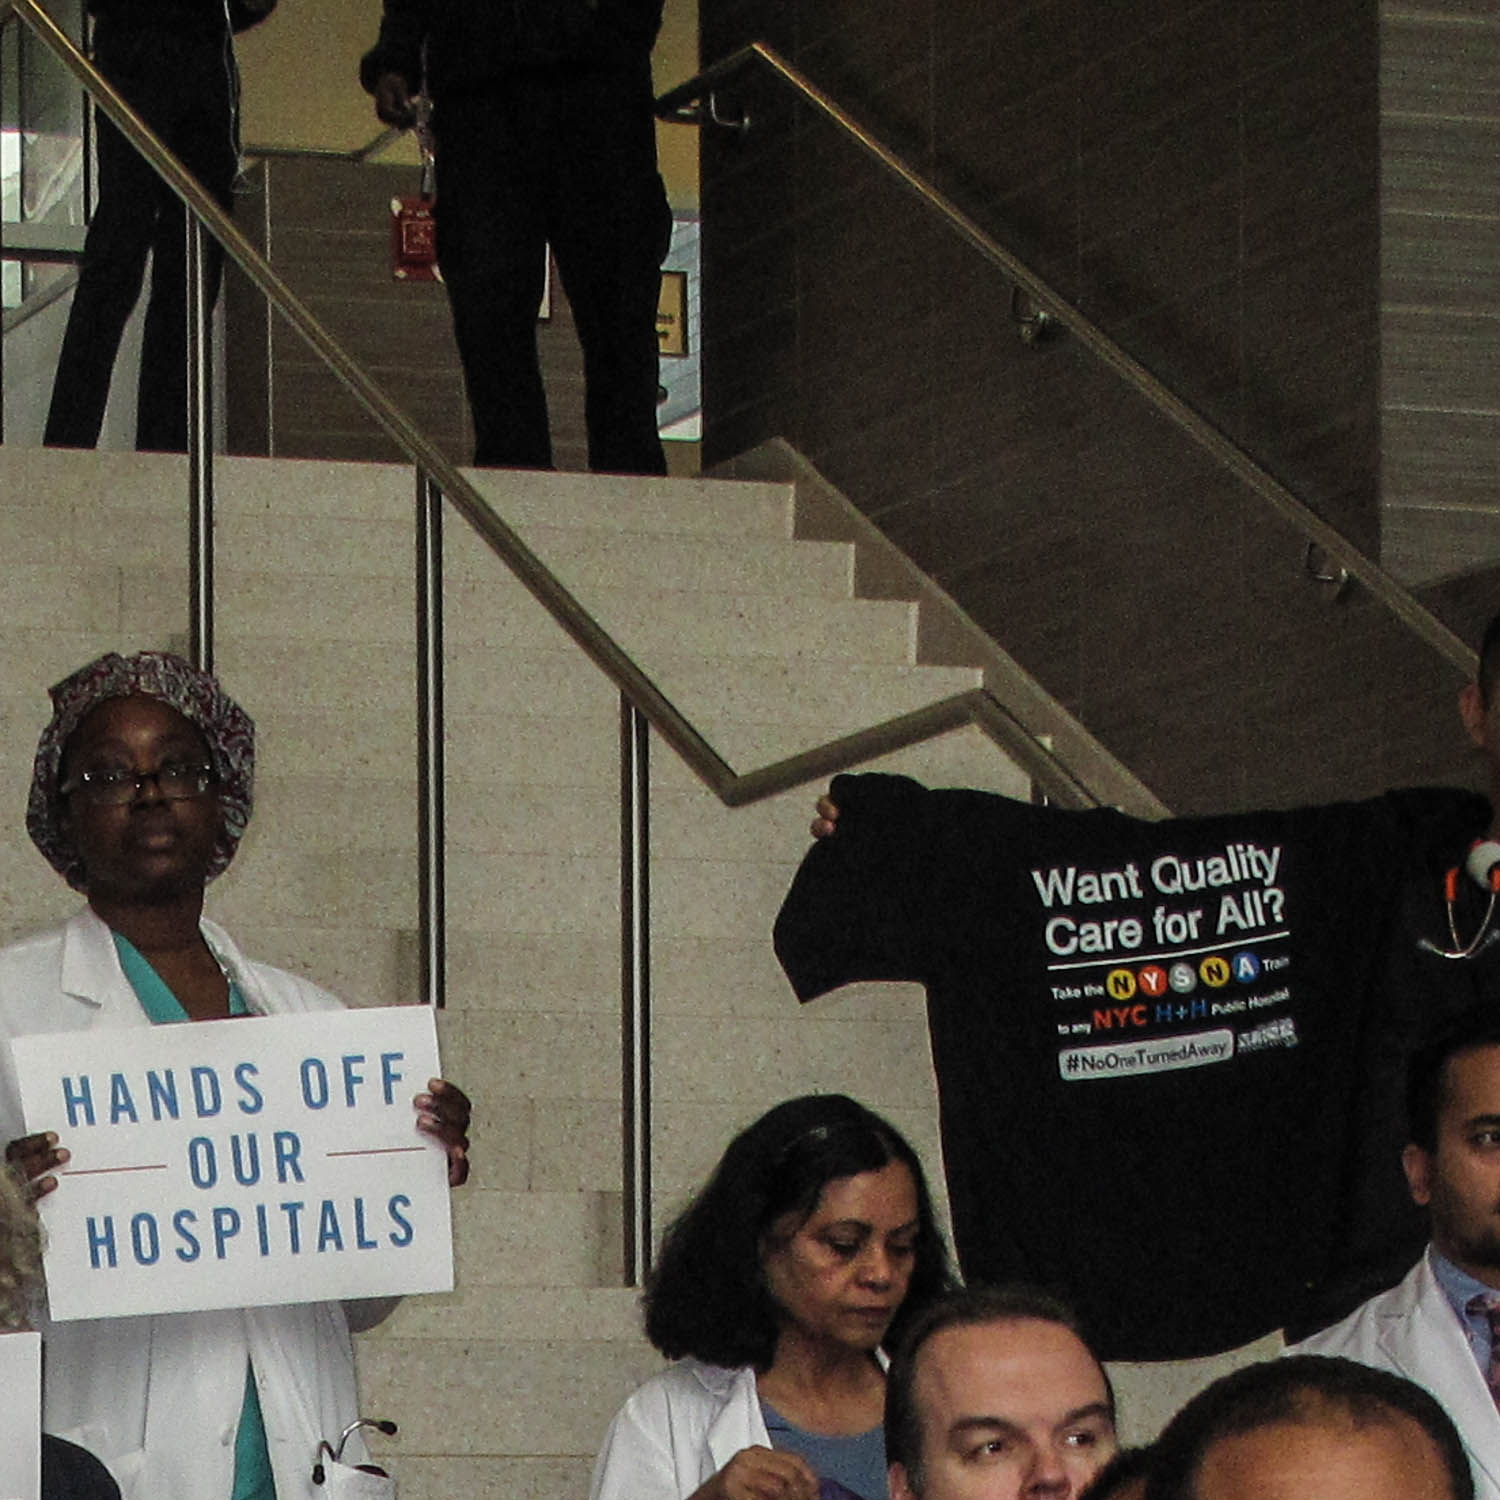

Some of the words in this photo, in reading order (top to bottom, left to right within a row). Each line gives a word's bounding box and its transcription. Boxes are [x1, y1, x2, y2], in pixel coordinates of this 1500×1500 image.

[1031, 866, 1144, 907] Want
[1150, 842, 1282, 895] Quality
[1045, 917, 1143, 956] Care
[1153, 906, 1203, 945] for
[1216, 887, 1286, 936] All?
[1093, 1004, 1149, 1029] NYC
[1156, 1000, 1208, 1023] H+H
[1066, 1041, 1227, 1073] #NoOneTurnedAway
[61, 1062, 265, 1128] HANDS
[301, 1052, 405, 1110] OFF
[189, 1130, 306, 1190] OUR
[86, 1194, 415, 1270] HOSPITALS
